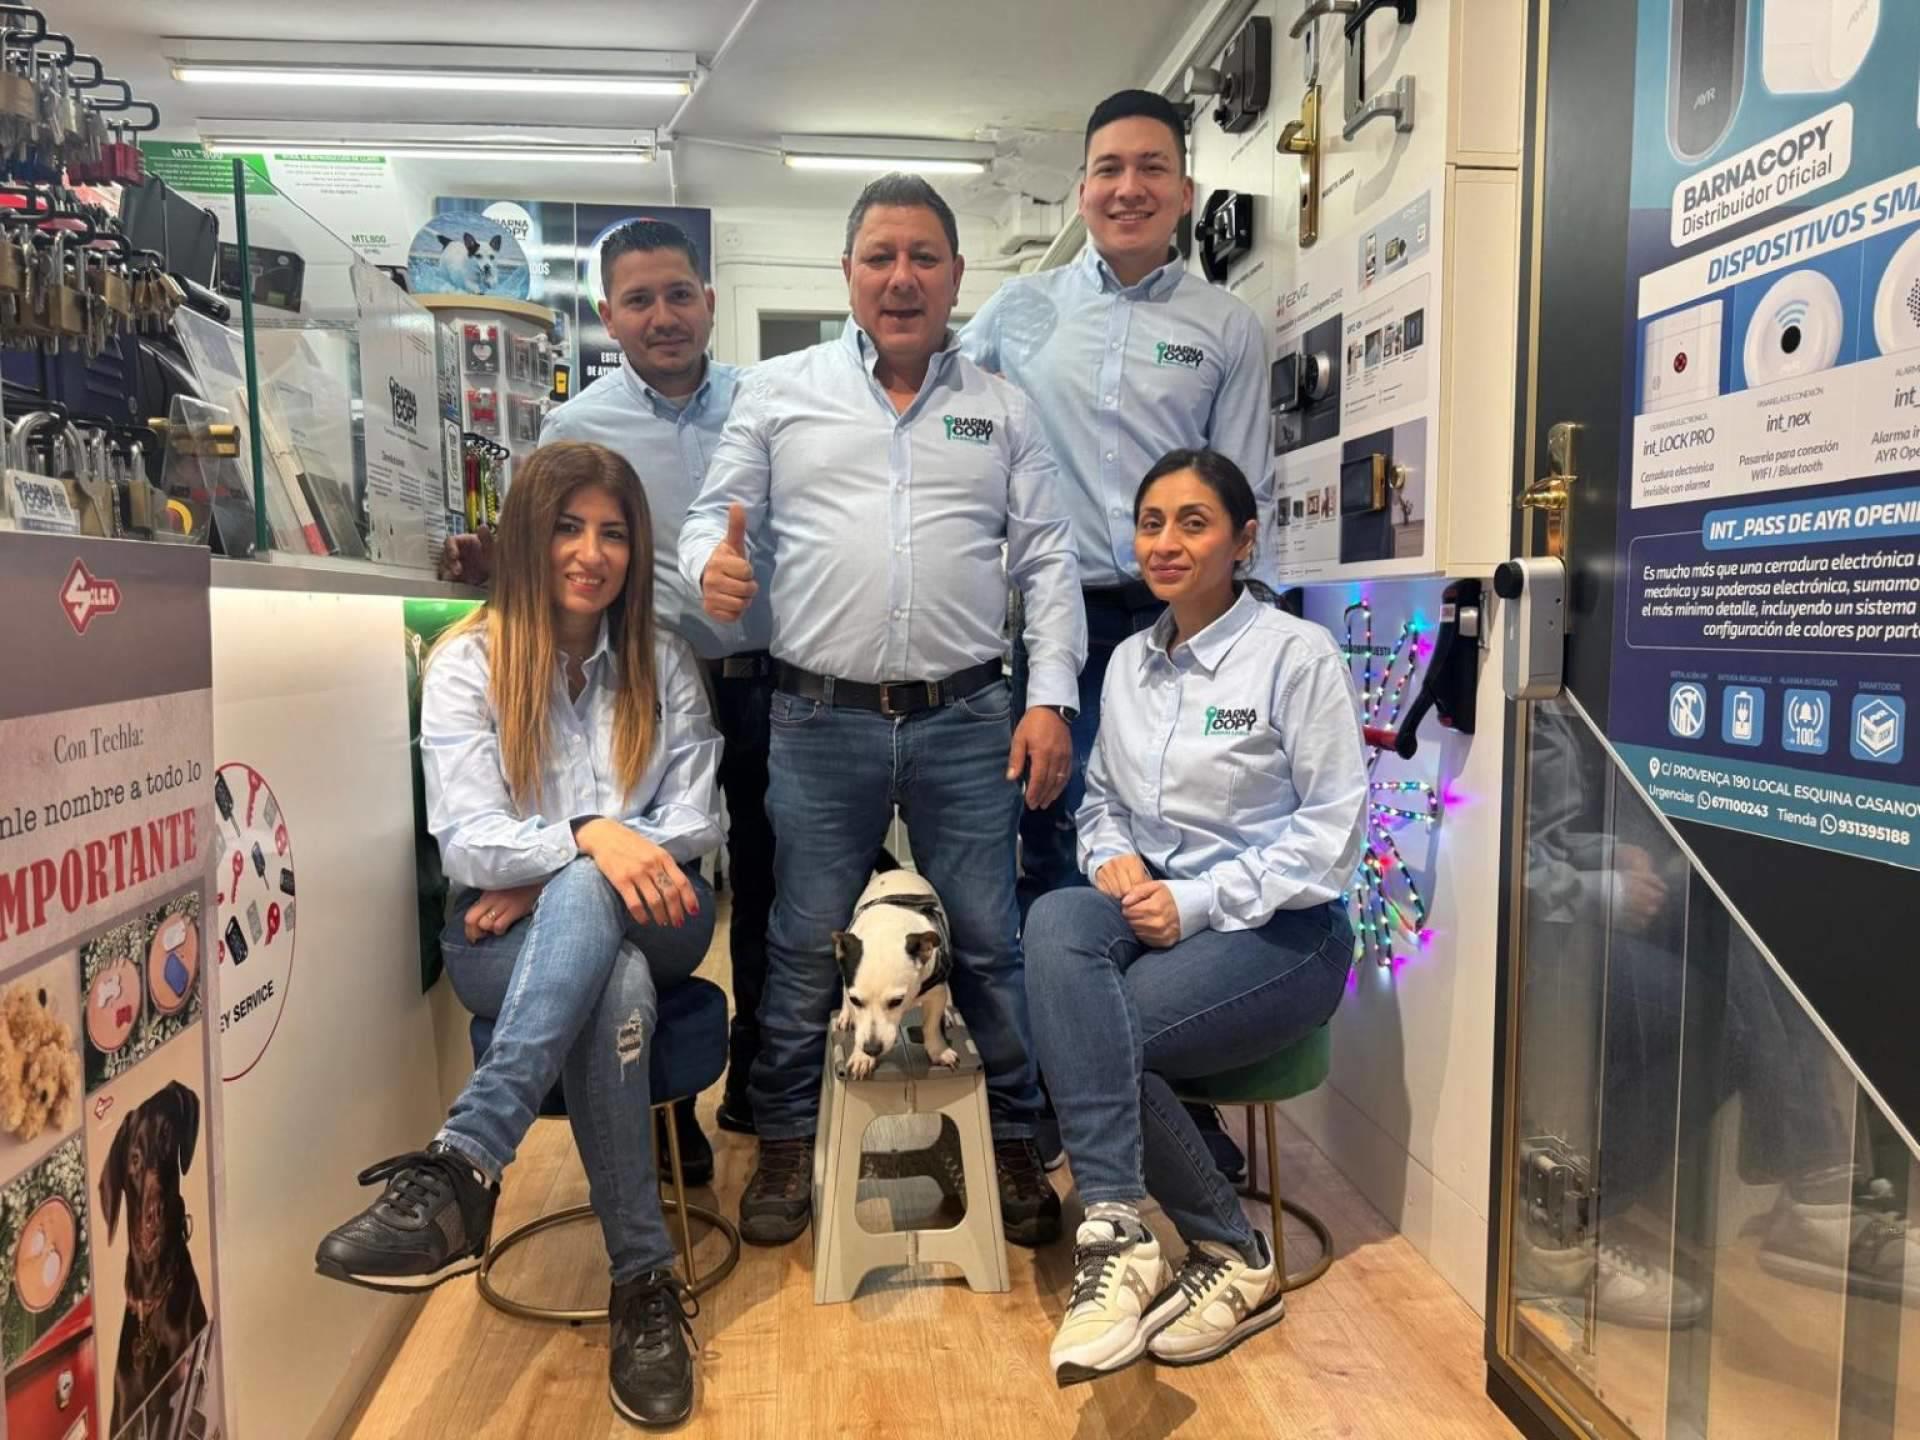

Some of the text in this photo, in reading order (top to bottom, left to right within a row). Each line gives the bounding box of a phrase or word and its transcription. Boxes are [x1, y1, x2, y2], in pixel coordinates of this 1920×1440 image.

[1683, 120, 1833, 213] BARNACOPY
[1682, 152, 1832, 237] Distribuidor Oficial
[1707, 201, 1867, 285] DISPOSITIVOS
[1164, 350, 1203, 367] COPY
[1167, 344, 1203, 355] BARNA
[952, 425, 993, 440] COPY
[954, 417, 993, 429] BARNA
[1766, 411, 1812, 432] int_nex
[1643, 427, 1715, 457] int_LOCK PRO
[1872, 430, 1911, 445] Alarma
[1739, 439, 1839, 466] Pasarela para conexión
[1875, 447, 1898, 463] AYR
[1641, 460, 1714, 483] Cerradura electrónica
[1778, 459, 1824, 477] Bluetooth
[1670, 483, 1683, 493] con
[1684, 479, 1710, 492] alarma
[1710, 515, 1785, 541] INT_PASS
[1787, 512, 1813, 533] DE
[1813, 508, 1851, 531] AYR
[1643, 565, 1655, 580] Es
[1656, 563, 1690, 579] mucho
[1691, 561, 1715, 578] más
[1716, 563, 1738, 579] que
[1740, 561, 1762, 575] una
[1764, 556, 1829, 574] cerradura
[1831, 551, 1915, 570] electrónica
[1644, 583, 1691, 599] mecánica
[1692, 586, 1699, 600] y
[1701, 585, 1714, 597] su
[1715, 581, 1771, 600] poderosa
[1773, 577, 1850, 595] electrónica,
[1641, 598, 1917, 619] el más mínimo detalle, incluyendo un sistema
[1703, 620, 1783, 640] configuración
[1785, 621, 1801, 637] de
[1803, 620, 1855, 638] colores
[1856, 624, 1882, 642] por
[1212, 718, 1256, 732] COPY
[1217, 708, 1256, 720] BARNA
[54, 722, 144, 764] Con Techla:
[1796, 727, 1814, 746] 100
[44, 784, 125, 826] nombre
[130, 780, 142, 800] a
[147, 765, 183, 796] todo
[187, 760, 201, 782] lo
[1661, 762, 1672, 776] C/
[1673, 764, 1730, 787] PROVENÇA
[1732, 774, 1751, 789] 190
[1752, 778, 1791, 797] LOCAL
[1794, 784, 1853, 807] ESQUINA
[1649, 784, 1911, 845] Urgencias 671100243 Tienda 931395188
[0, 807, 197, 942] MPORTANTE
[233, 979, 274, 1022] SERVICE
